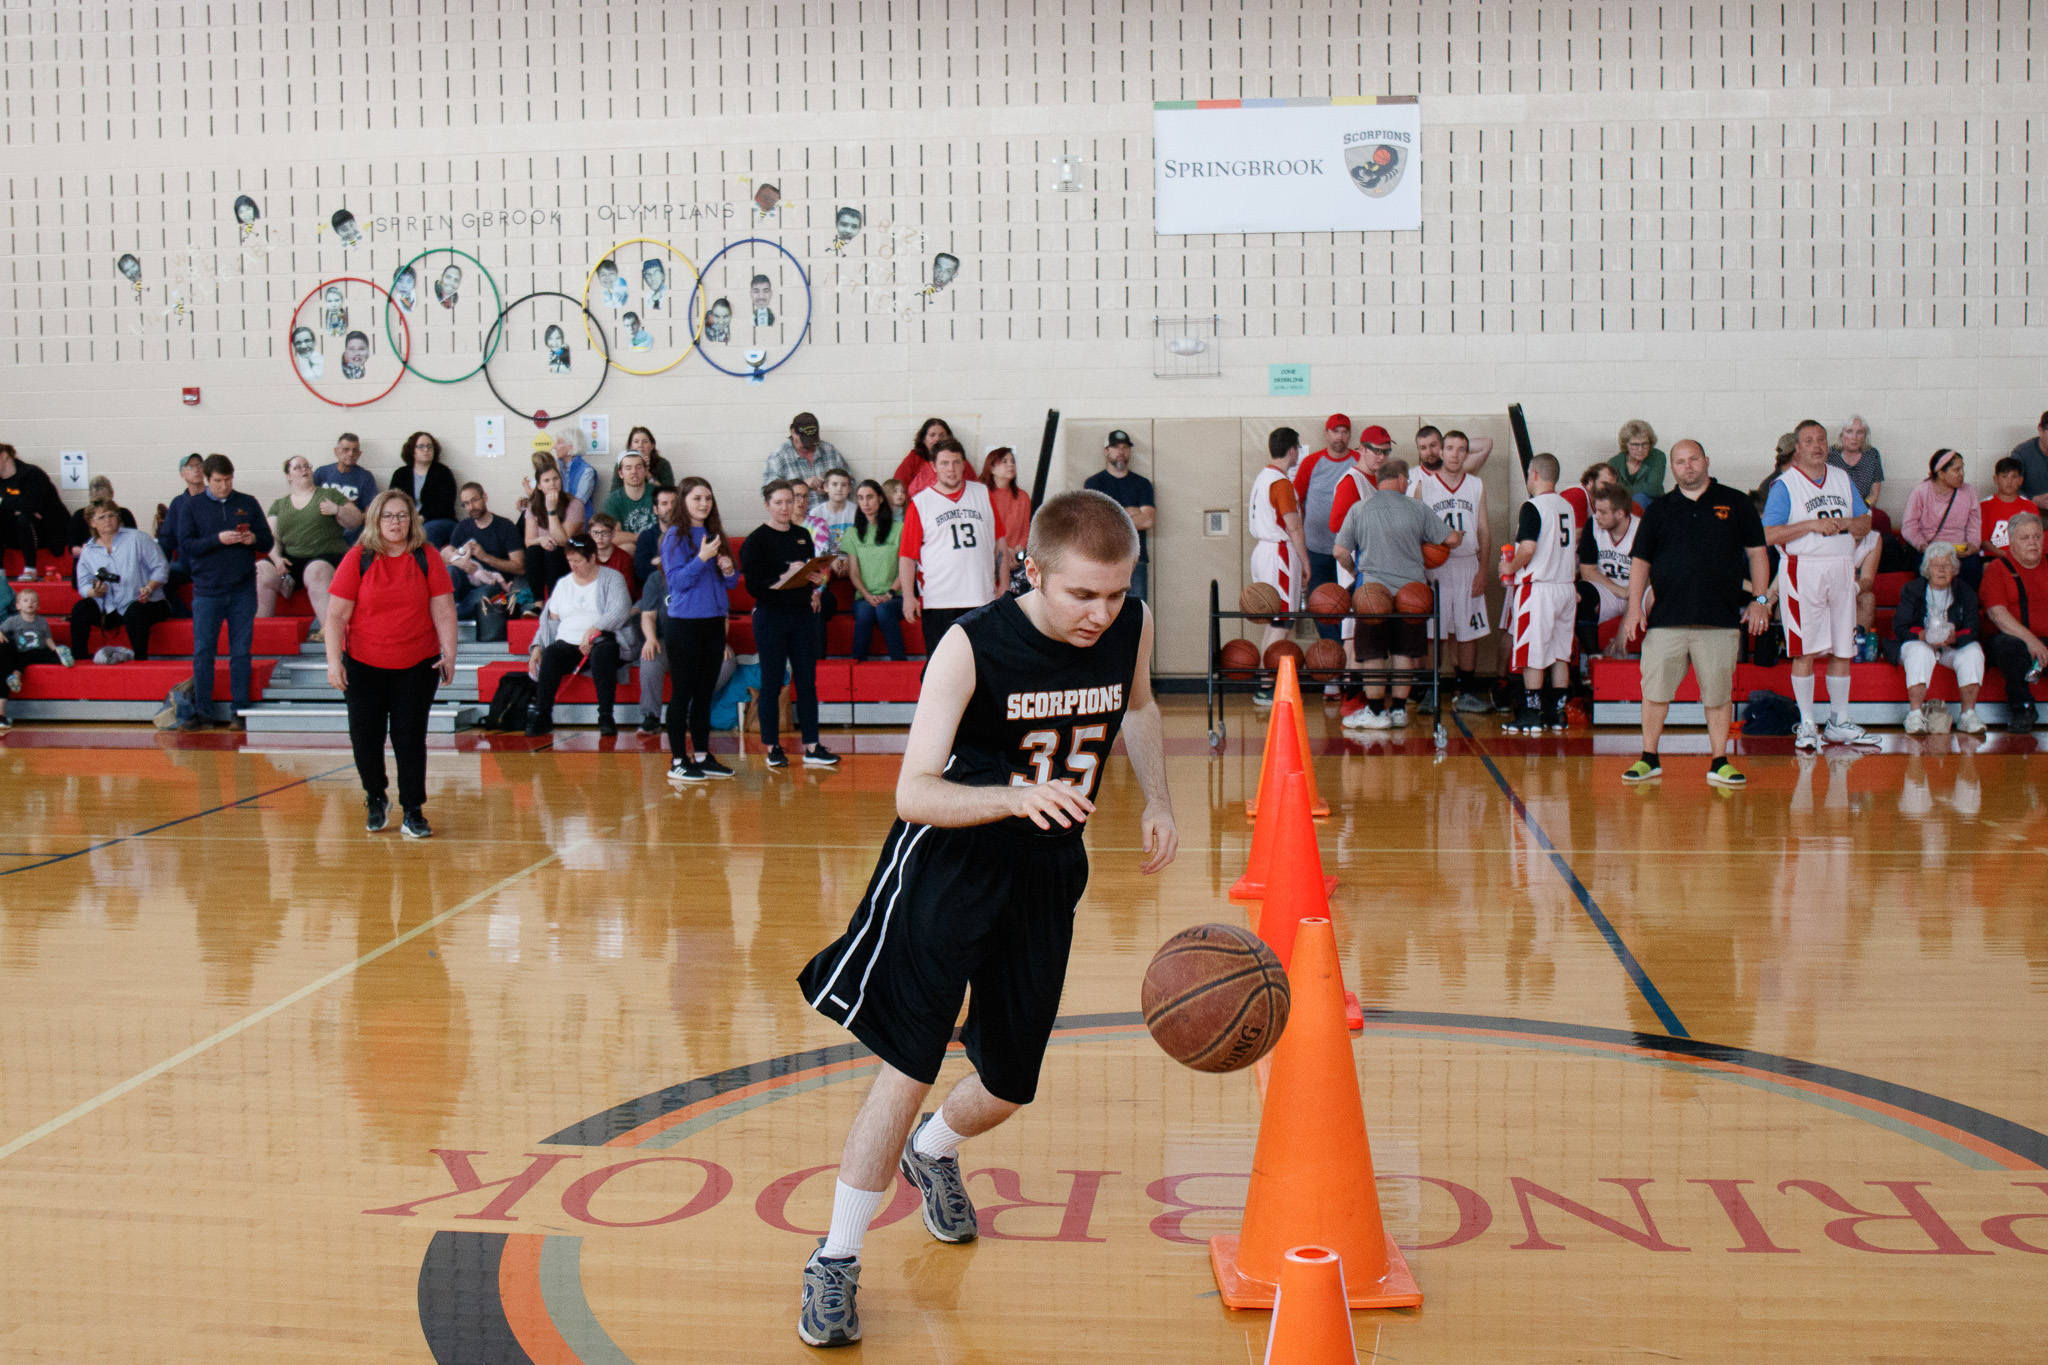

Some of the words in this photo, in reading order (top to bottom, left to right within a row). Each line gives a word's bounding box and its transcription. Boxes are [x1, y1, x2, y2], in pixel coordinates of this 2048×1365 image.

[1343, 130, 1412, 145] SCORPIONS
[1164, 159, 1325, 179] SPRINGBROOK
[597, 202, 735, 221] OLYMPIANS
[1805, 495, 1848, 513] BROOME-TIOGA
[935, 508, 984, 527] BROOME-TIOGA
[950, 522, 977, 550] 13
[1558, 513, 1571, 548] 5
[1469, 612, 1486, 630] 41
[1006, 683, 1123, 721] SCORPIONS
[1009, 723, 1108, 799] 35
